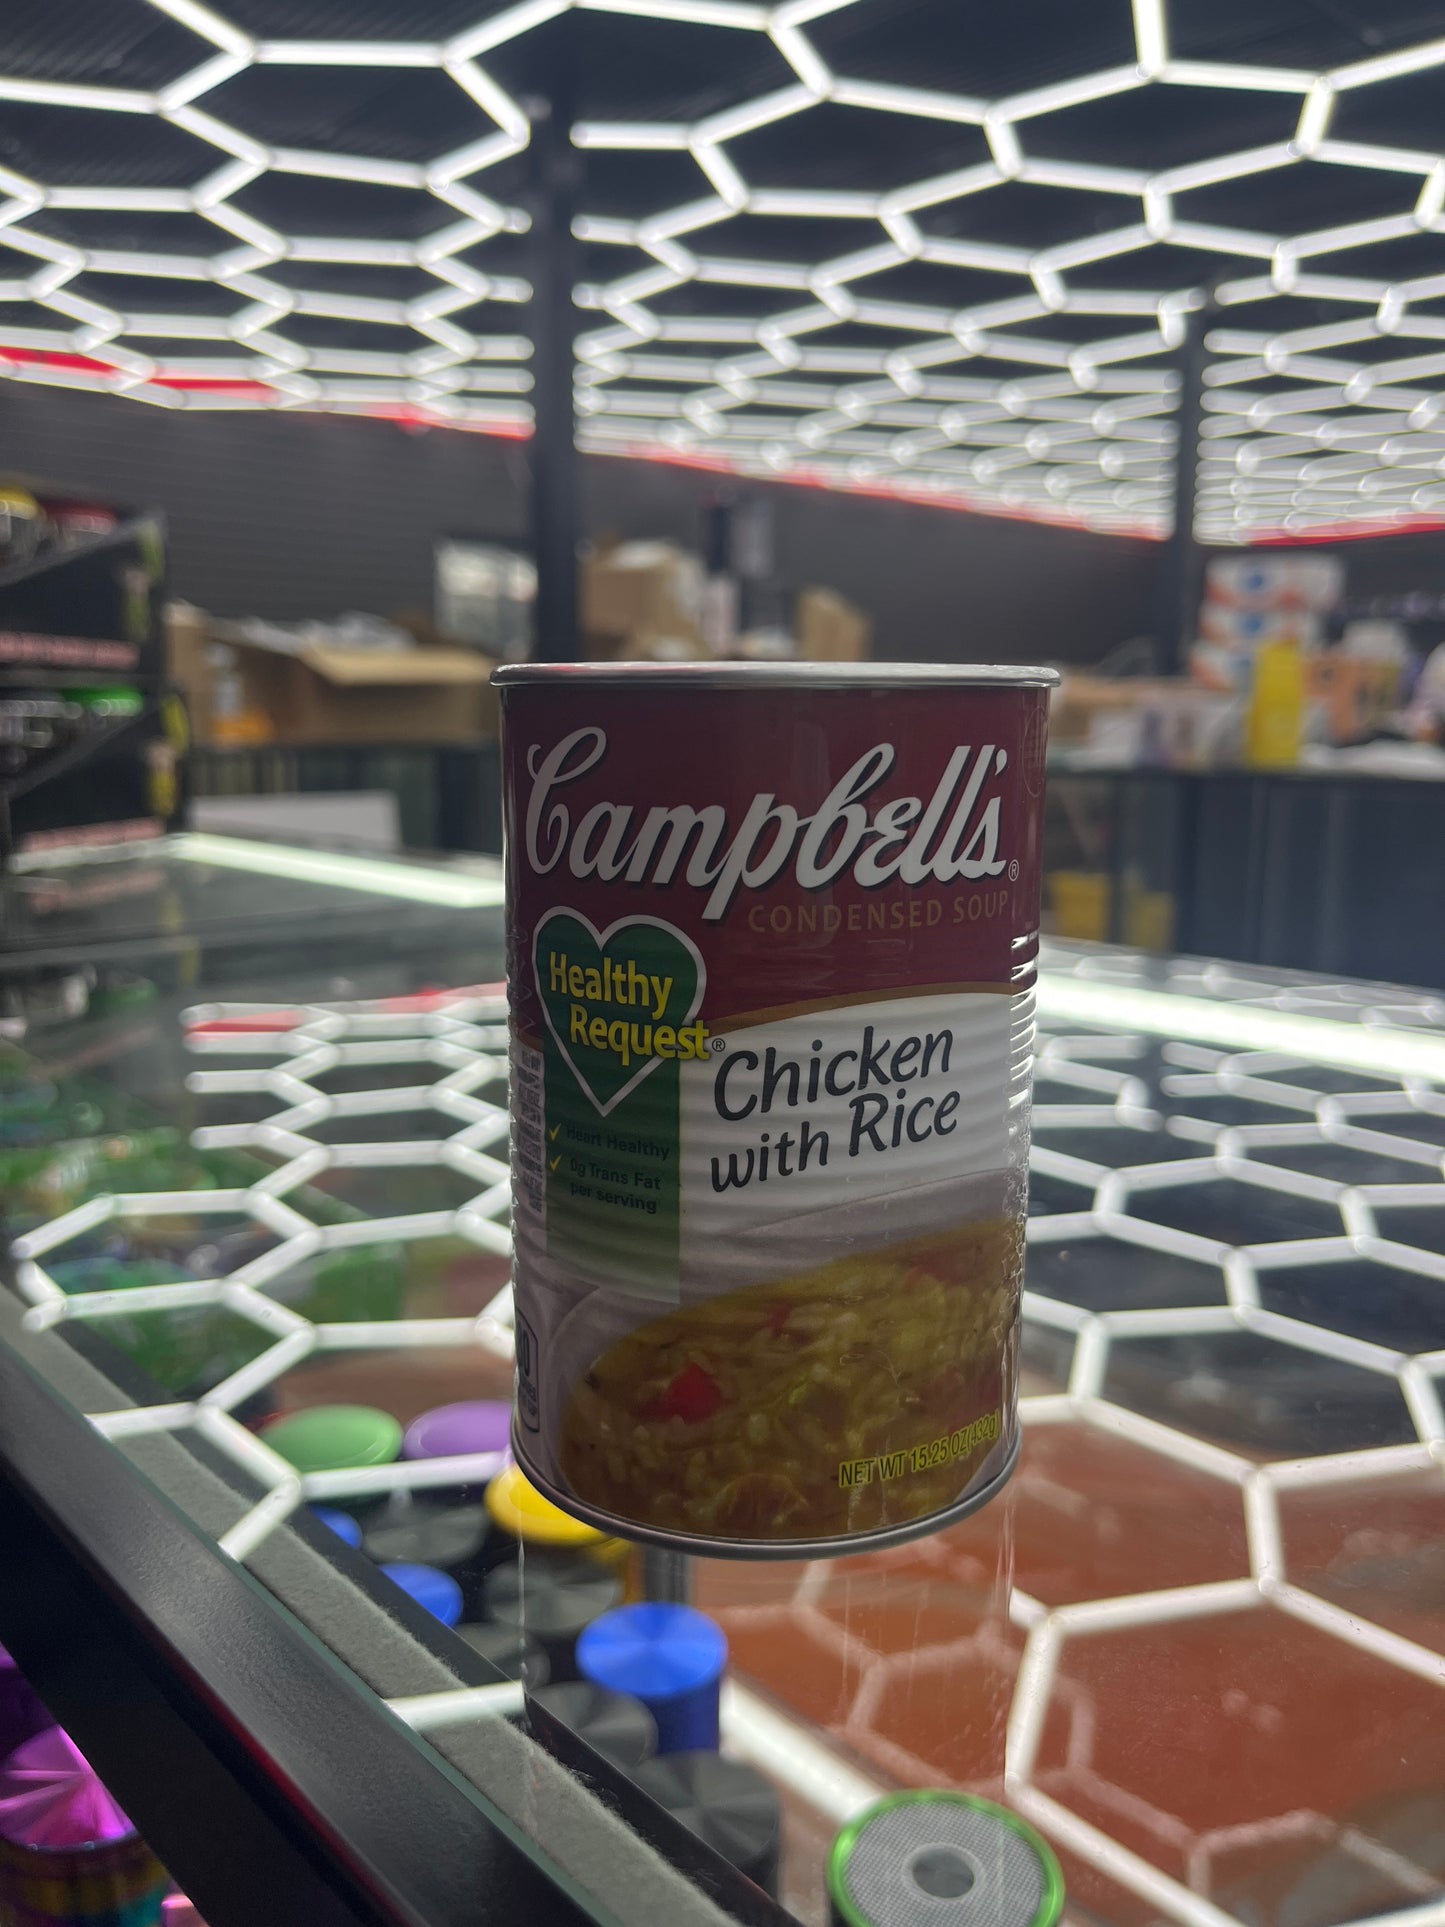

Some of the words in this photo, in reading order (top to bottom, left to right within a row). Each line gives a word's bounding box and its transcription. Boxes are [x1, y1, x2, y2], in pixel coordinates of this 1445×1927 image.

[748, 897, 942, 934] CONDENSED
[953, 890, 1009, 924] SOUP
[549, 951, 673, 1020] Healthy
[713, 1025, 953, 1121] Chicken
[566, 1125, 602, 1146] Heart
[607, 1135, 670, 1160] Healthy
[711, 1122, 829, 1192] with
[849, 1089, 960, 1157] Rice
[570, 1158, 586, 1177] 0g
[588, 1162, 629, 1184] Trans
[634, 1172, 661, 1190] Fat
[570, 1182, 592, 1197] per
[596, 1190, 657, 1214] serving
[840, 1459, 875, 1488] NET
[878, 1453, 907, 1481] WT
[909, 1437, 950, 1472] 15.25
